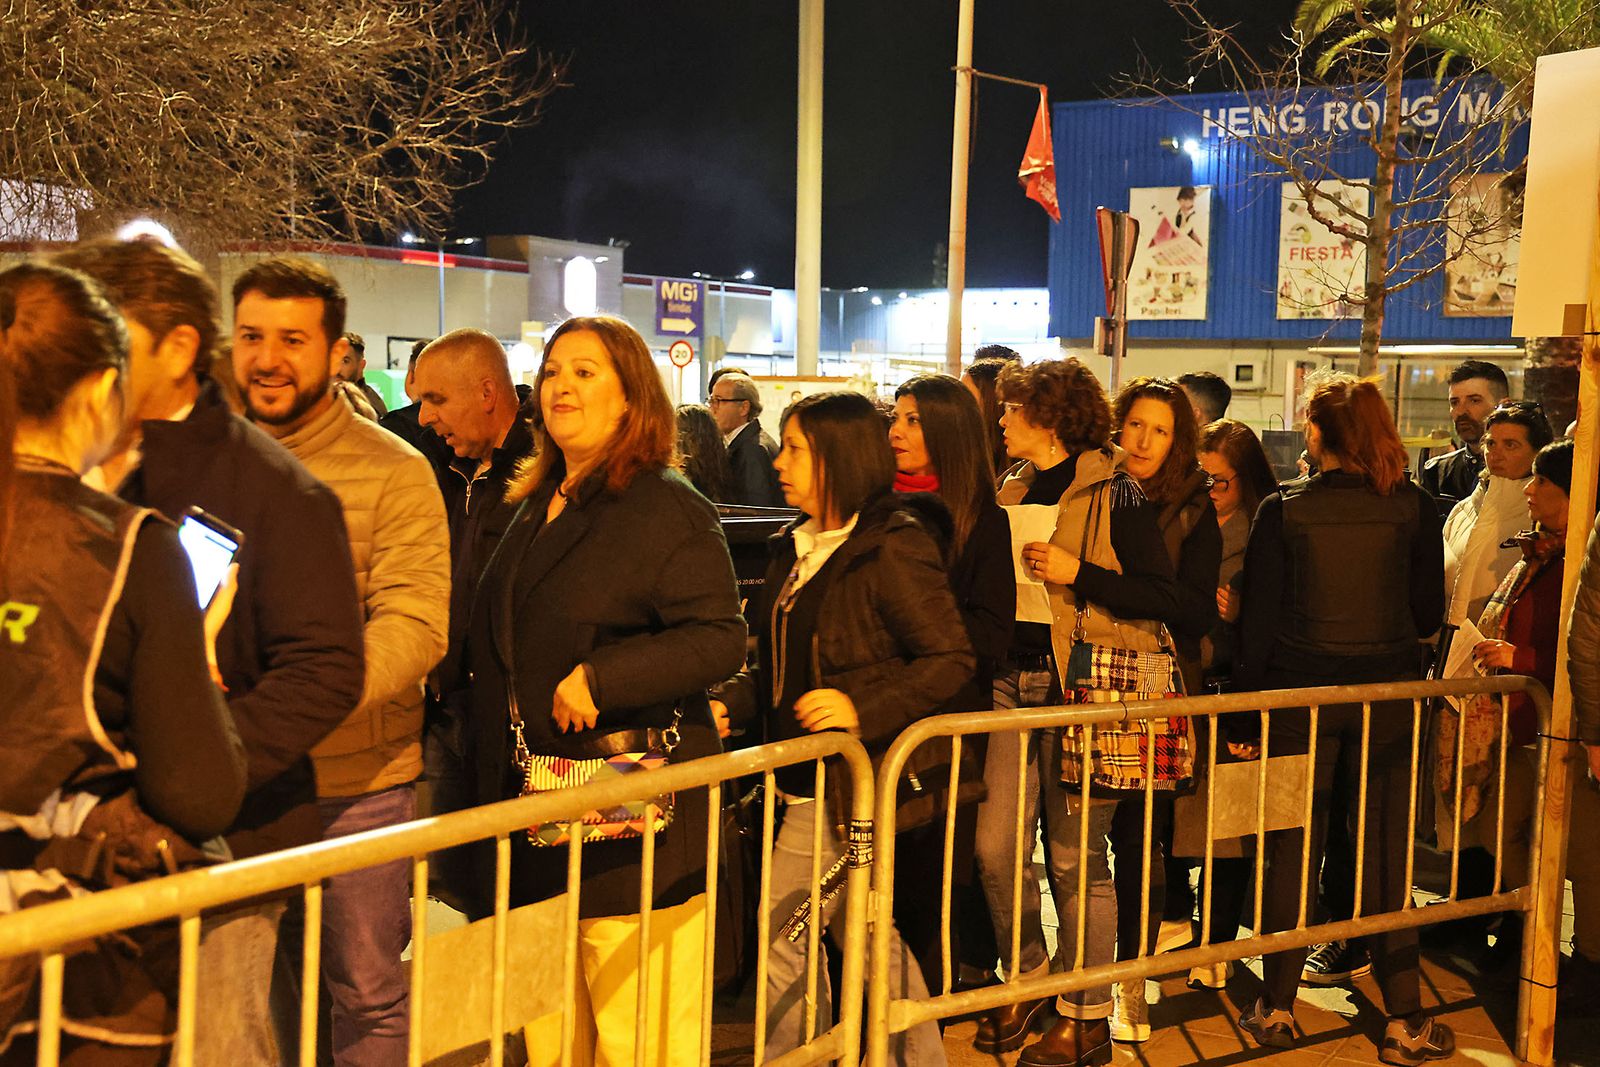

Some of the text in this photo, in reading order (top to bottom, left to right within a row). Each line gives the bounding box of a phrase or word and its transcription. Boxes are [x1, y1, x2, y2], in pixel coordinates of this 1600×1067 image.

[1202, 103, 1307, 138] HENG
[1289, 245, 1353, 261] FIESTA
[675, 350, 688, 359] 20
